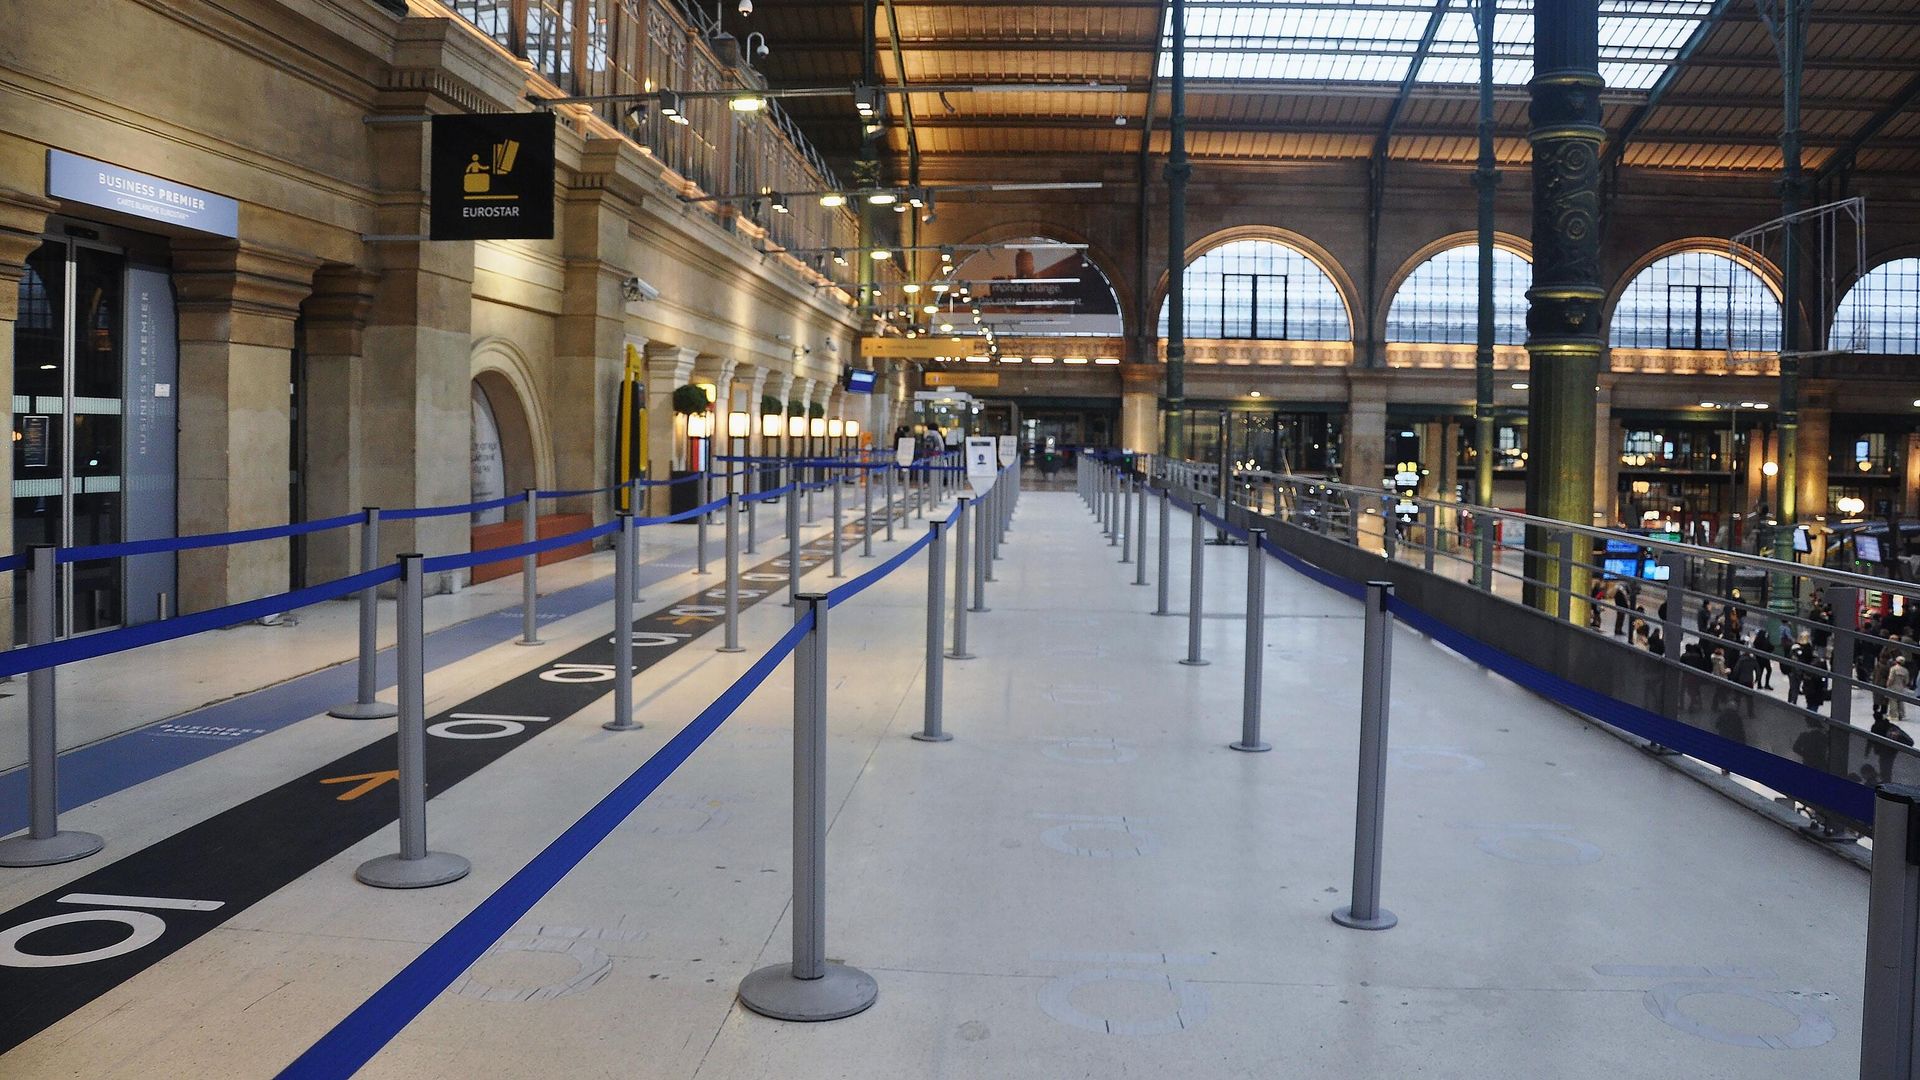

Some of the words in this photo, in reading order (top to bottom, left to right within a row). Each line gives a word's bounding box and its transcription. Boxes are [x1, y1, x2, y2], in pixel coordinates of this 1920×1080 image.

[99, 173, 155, 197] BUSINESS
[158, 189, 205, 209] PREMIER
[462, 206, 520, 218] EUROSTAR
[992, 284, 1024, 293] monde
[140, 291, 149, 367] PREMIER
[139, 373, 149, 455] BUSINESS
